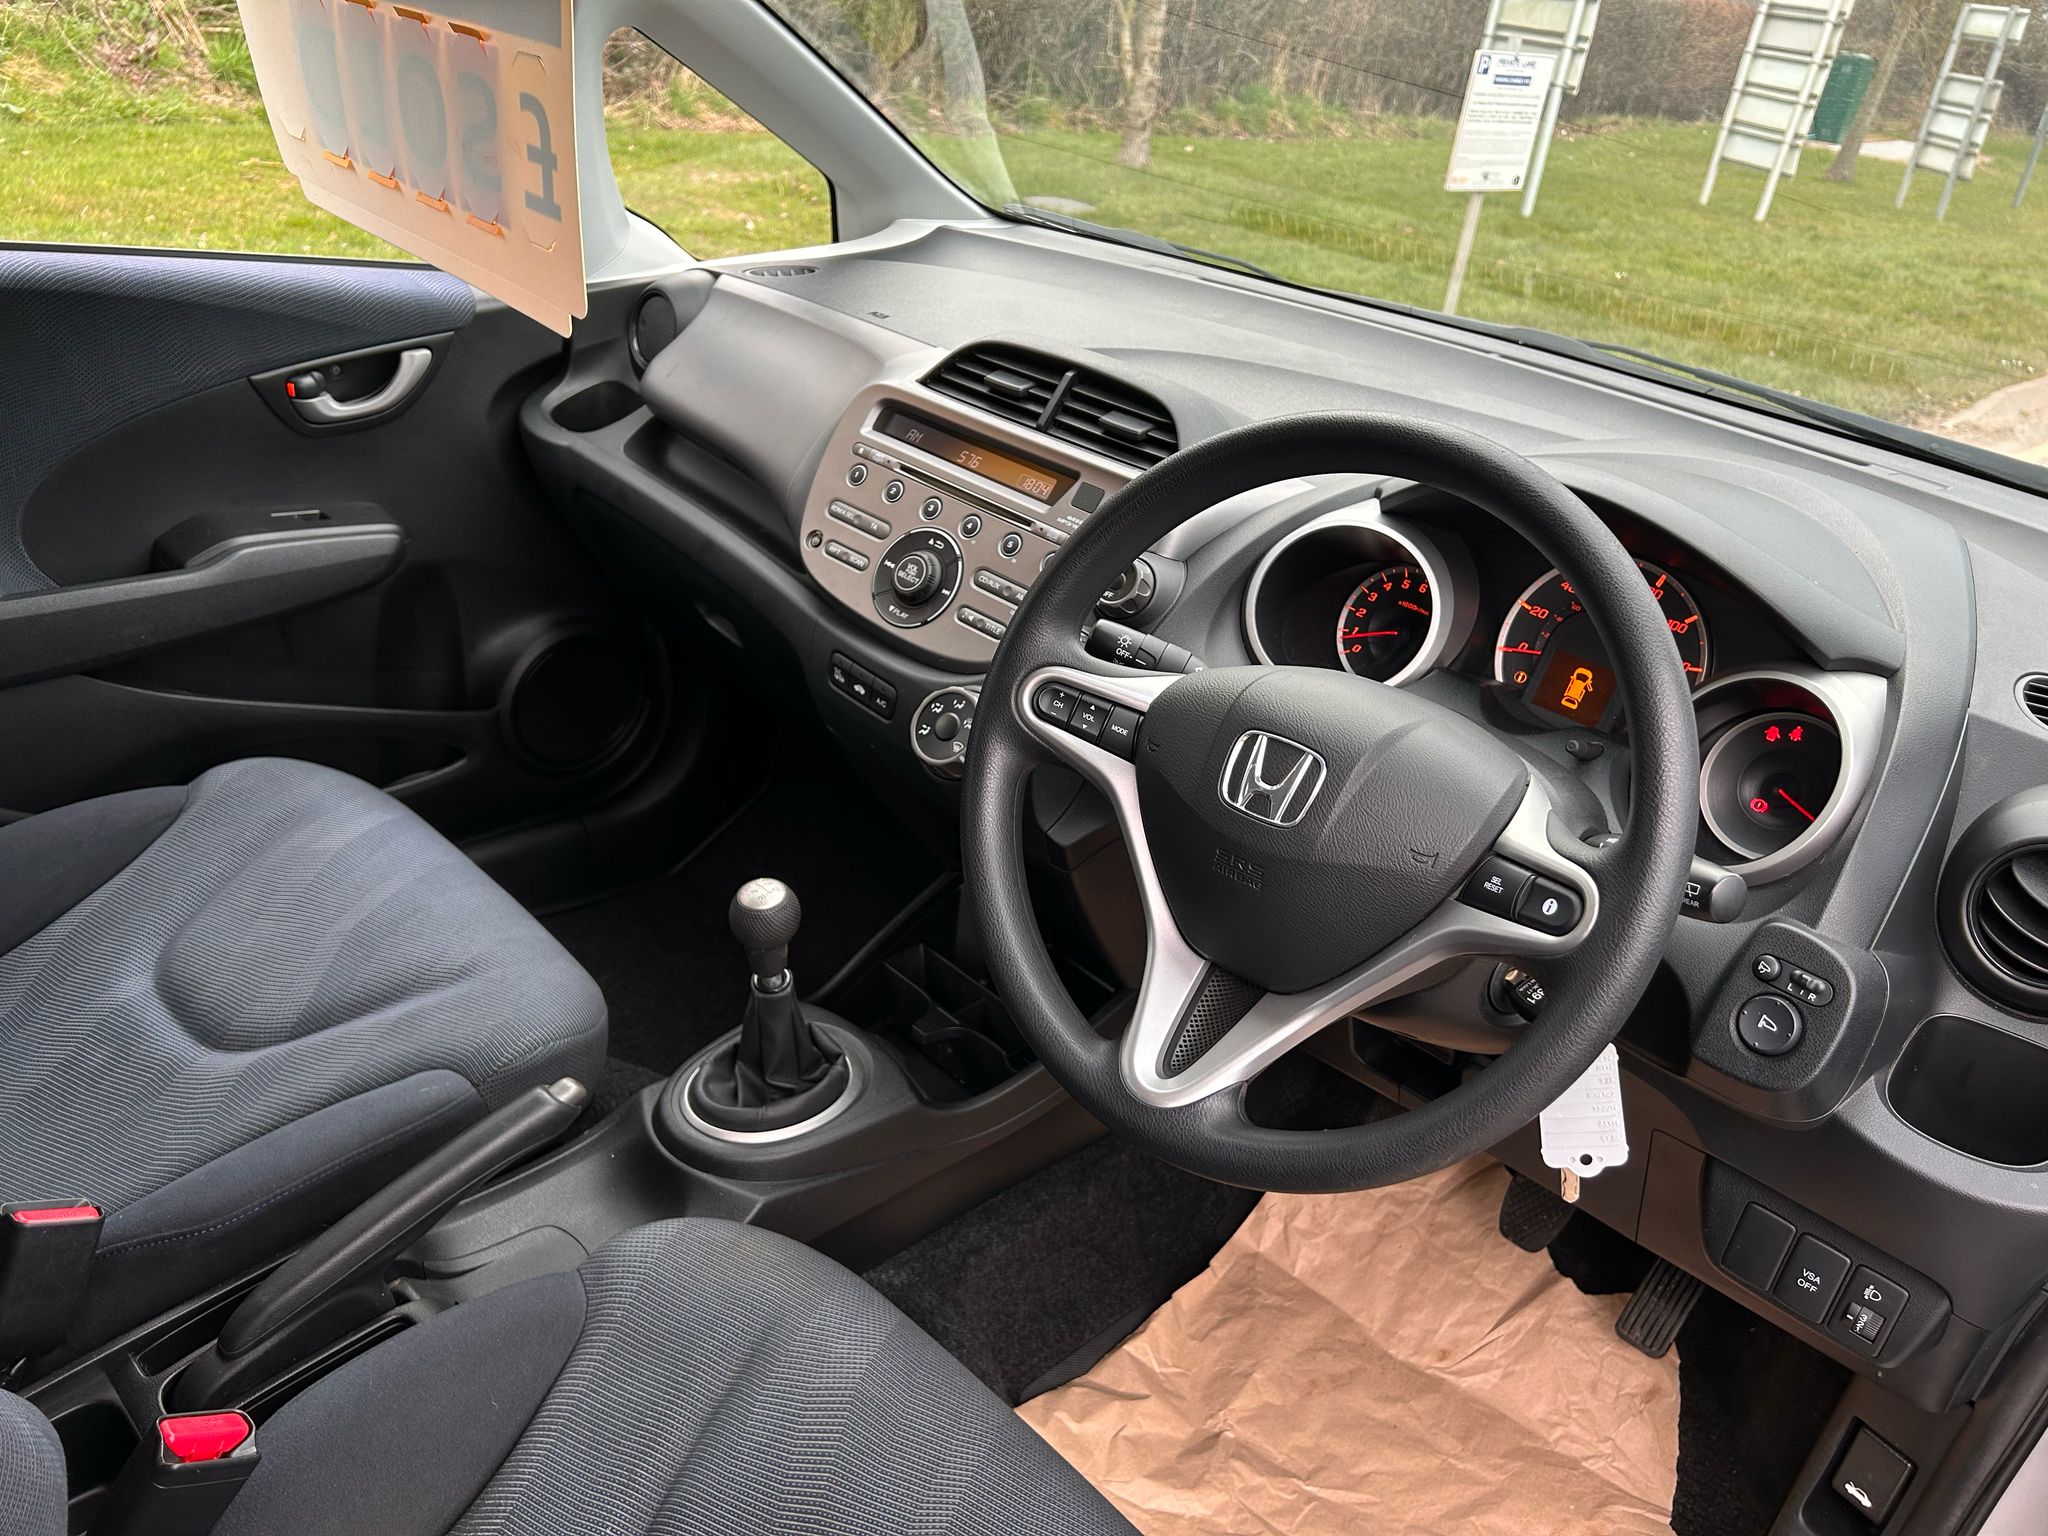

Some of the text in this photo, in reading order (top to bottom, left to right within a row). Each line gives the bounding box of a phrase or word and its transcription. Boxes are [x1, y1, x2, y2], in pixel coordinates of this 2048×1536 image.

[905, 428, 1051, 496] AM 576 1804
[889, 487, 897, 495] 2
[927, 504, 935, 512] 3
[849, 555, 865, 567] SCAN
[907, 562, 919, 572] VOL
[898, 570, 920, 584] SELECT
[1383, 582, 1392, 591] 4
[1401, 579, 1411, 589] 5
[1418, 583, 1428, 593] 6
[1367, 592, 1378, 602] 3
[892, 607, 909, 619] PLAY
[1355, 607, 1367, 618] 2
[1529, 605, 1550, 620] 20
[984, 622, 1002, 635] TITLE
[1352, 627, 1359, 635] 1
[1115, 647, 1131, 659] OFF
[1351, 644, 1362, 653] 0
[1053, 700, 1064, 709] CH
[1082, 712, 1095, 723] VOL
[1110, 724, 1129, 737] MODE
[1490, 875, 1502, 886] SEL
[1483, 881, 1504, 894] RESET
[1787, 982, 1793, 992] L
[1807, 992, 1817, 1002] R
[1802, 1268, 1821, 1285] VSA
[1797, 1278, 1818, 1292] OFF
